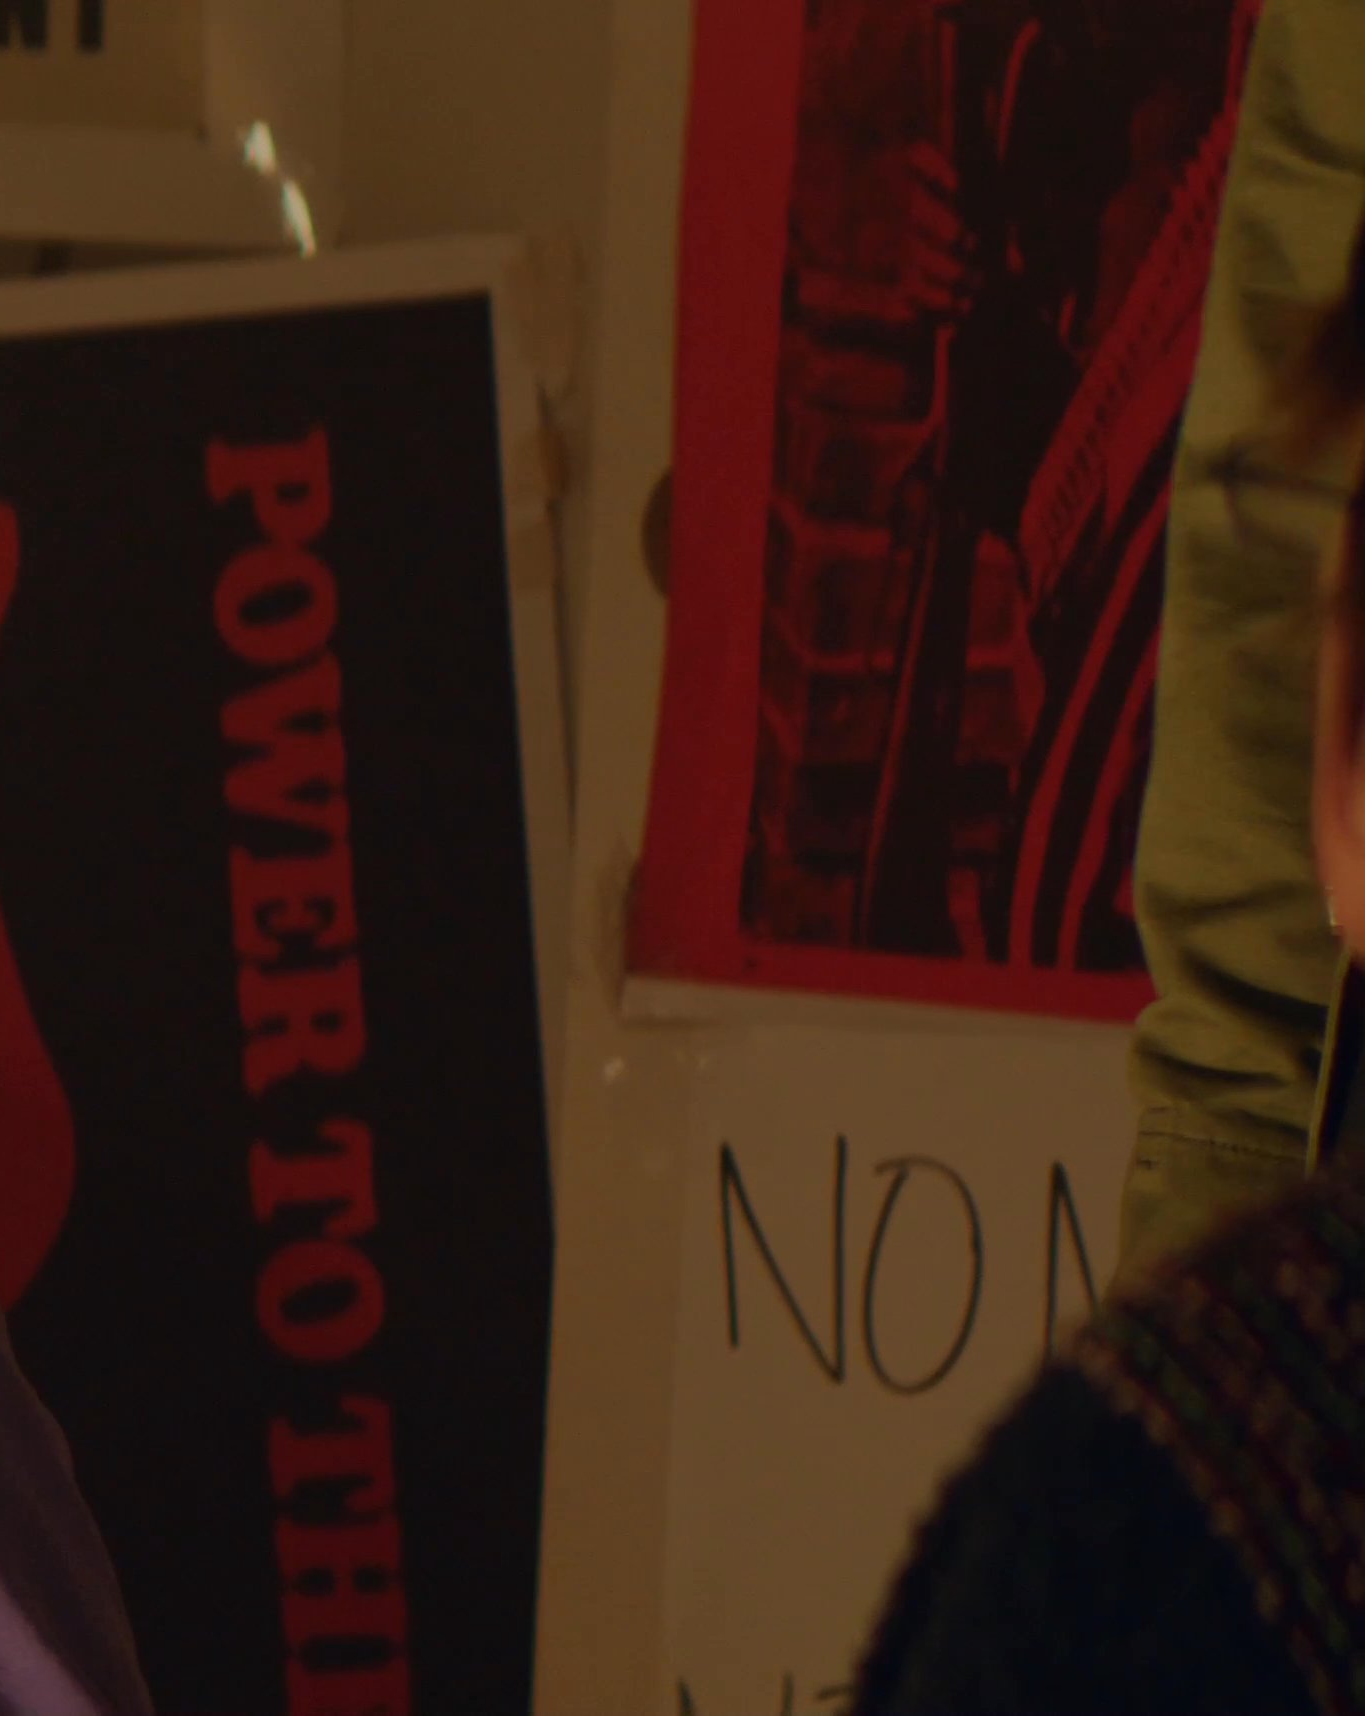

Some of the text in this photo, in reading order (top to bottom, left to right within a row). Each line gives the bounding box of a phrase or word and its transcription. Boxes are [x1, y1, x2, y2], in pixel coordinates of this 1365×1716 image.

[205, 424, 371, 1100] POWER
[247, 1112, 388, 1364] TO
[719, 1133, 986, 1396] NO
